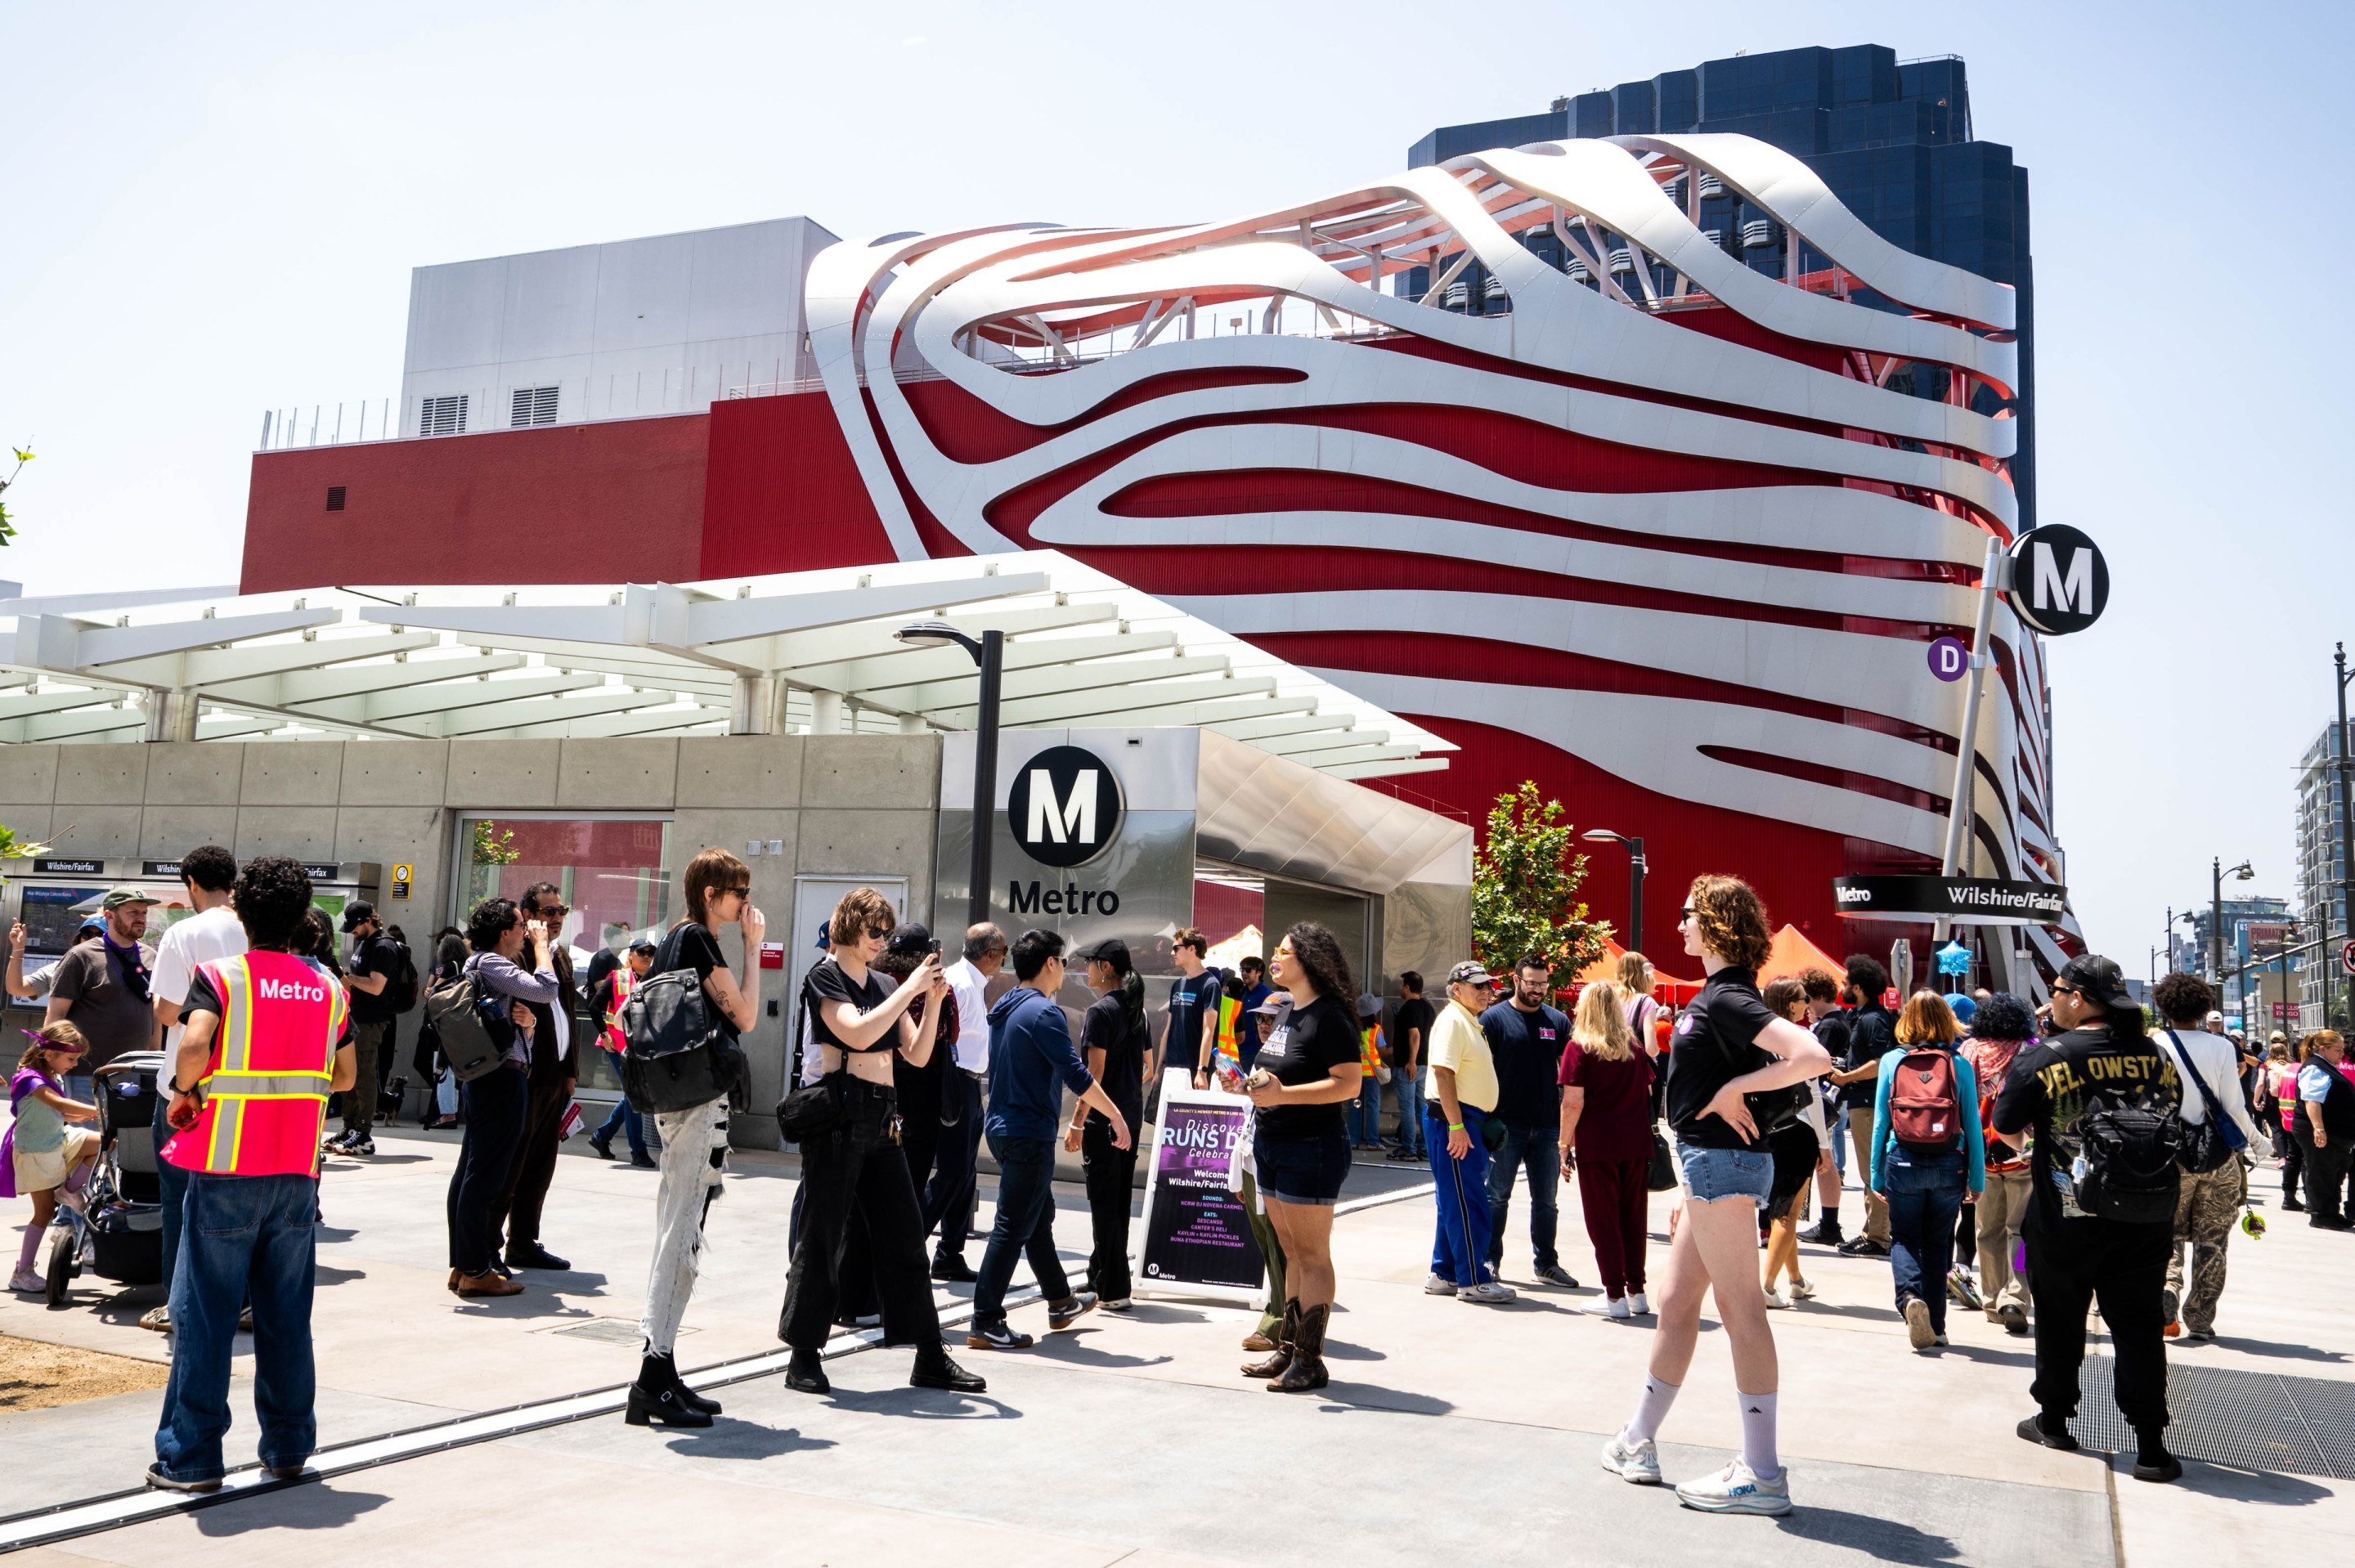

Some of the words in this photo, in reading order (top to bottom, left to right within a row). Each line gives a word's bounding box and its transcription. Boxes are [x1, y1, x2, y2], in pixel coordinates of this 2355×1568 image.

[2033, 541, 2093, 616] M
[1941, 645, 1959, 673] D
[1027, 768, 1098, 844] M
[47, 862, 95, 871] Wilshire/Fairfax
[1008, 880, 1119, 916] Metro
[1836, 885, 1872, 903] Metro
[2251, 927, 2281, 939] PRIMAT
[259, 978, 325, 1002] Metro
[1161, 1127, 1219, 1149] RUNS
[1169, 1177, 1229, 1189] Wilshire/Fairfa
[1194, 1169, 1229, 1179] Welcome
[1159, 1272, 1176, 1280] Metro
[1728, 1483, 1756, 1498] HOKA
